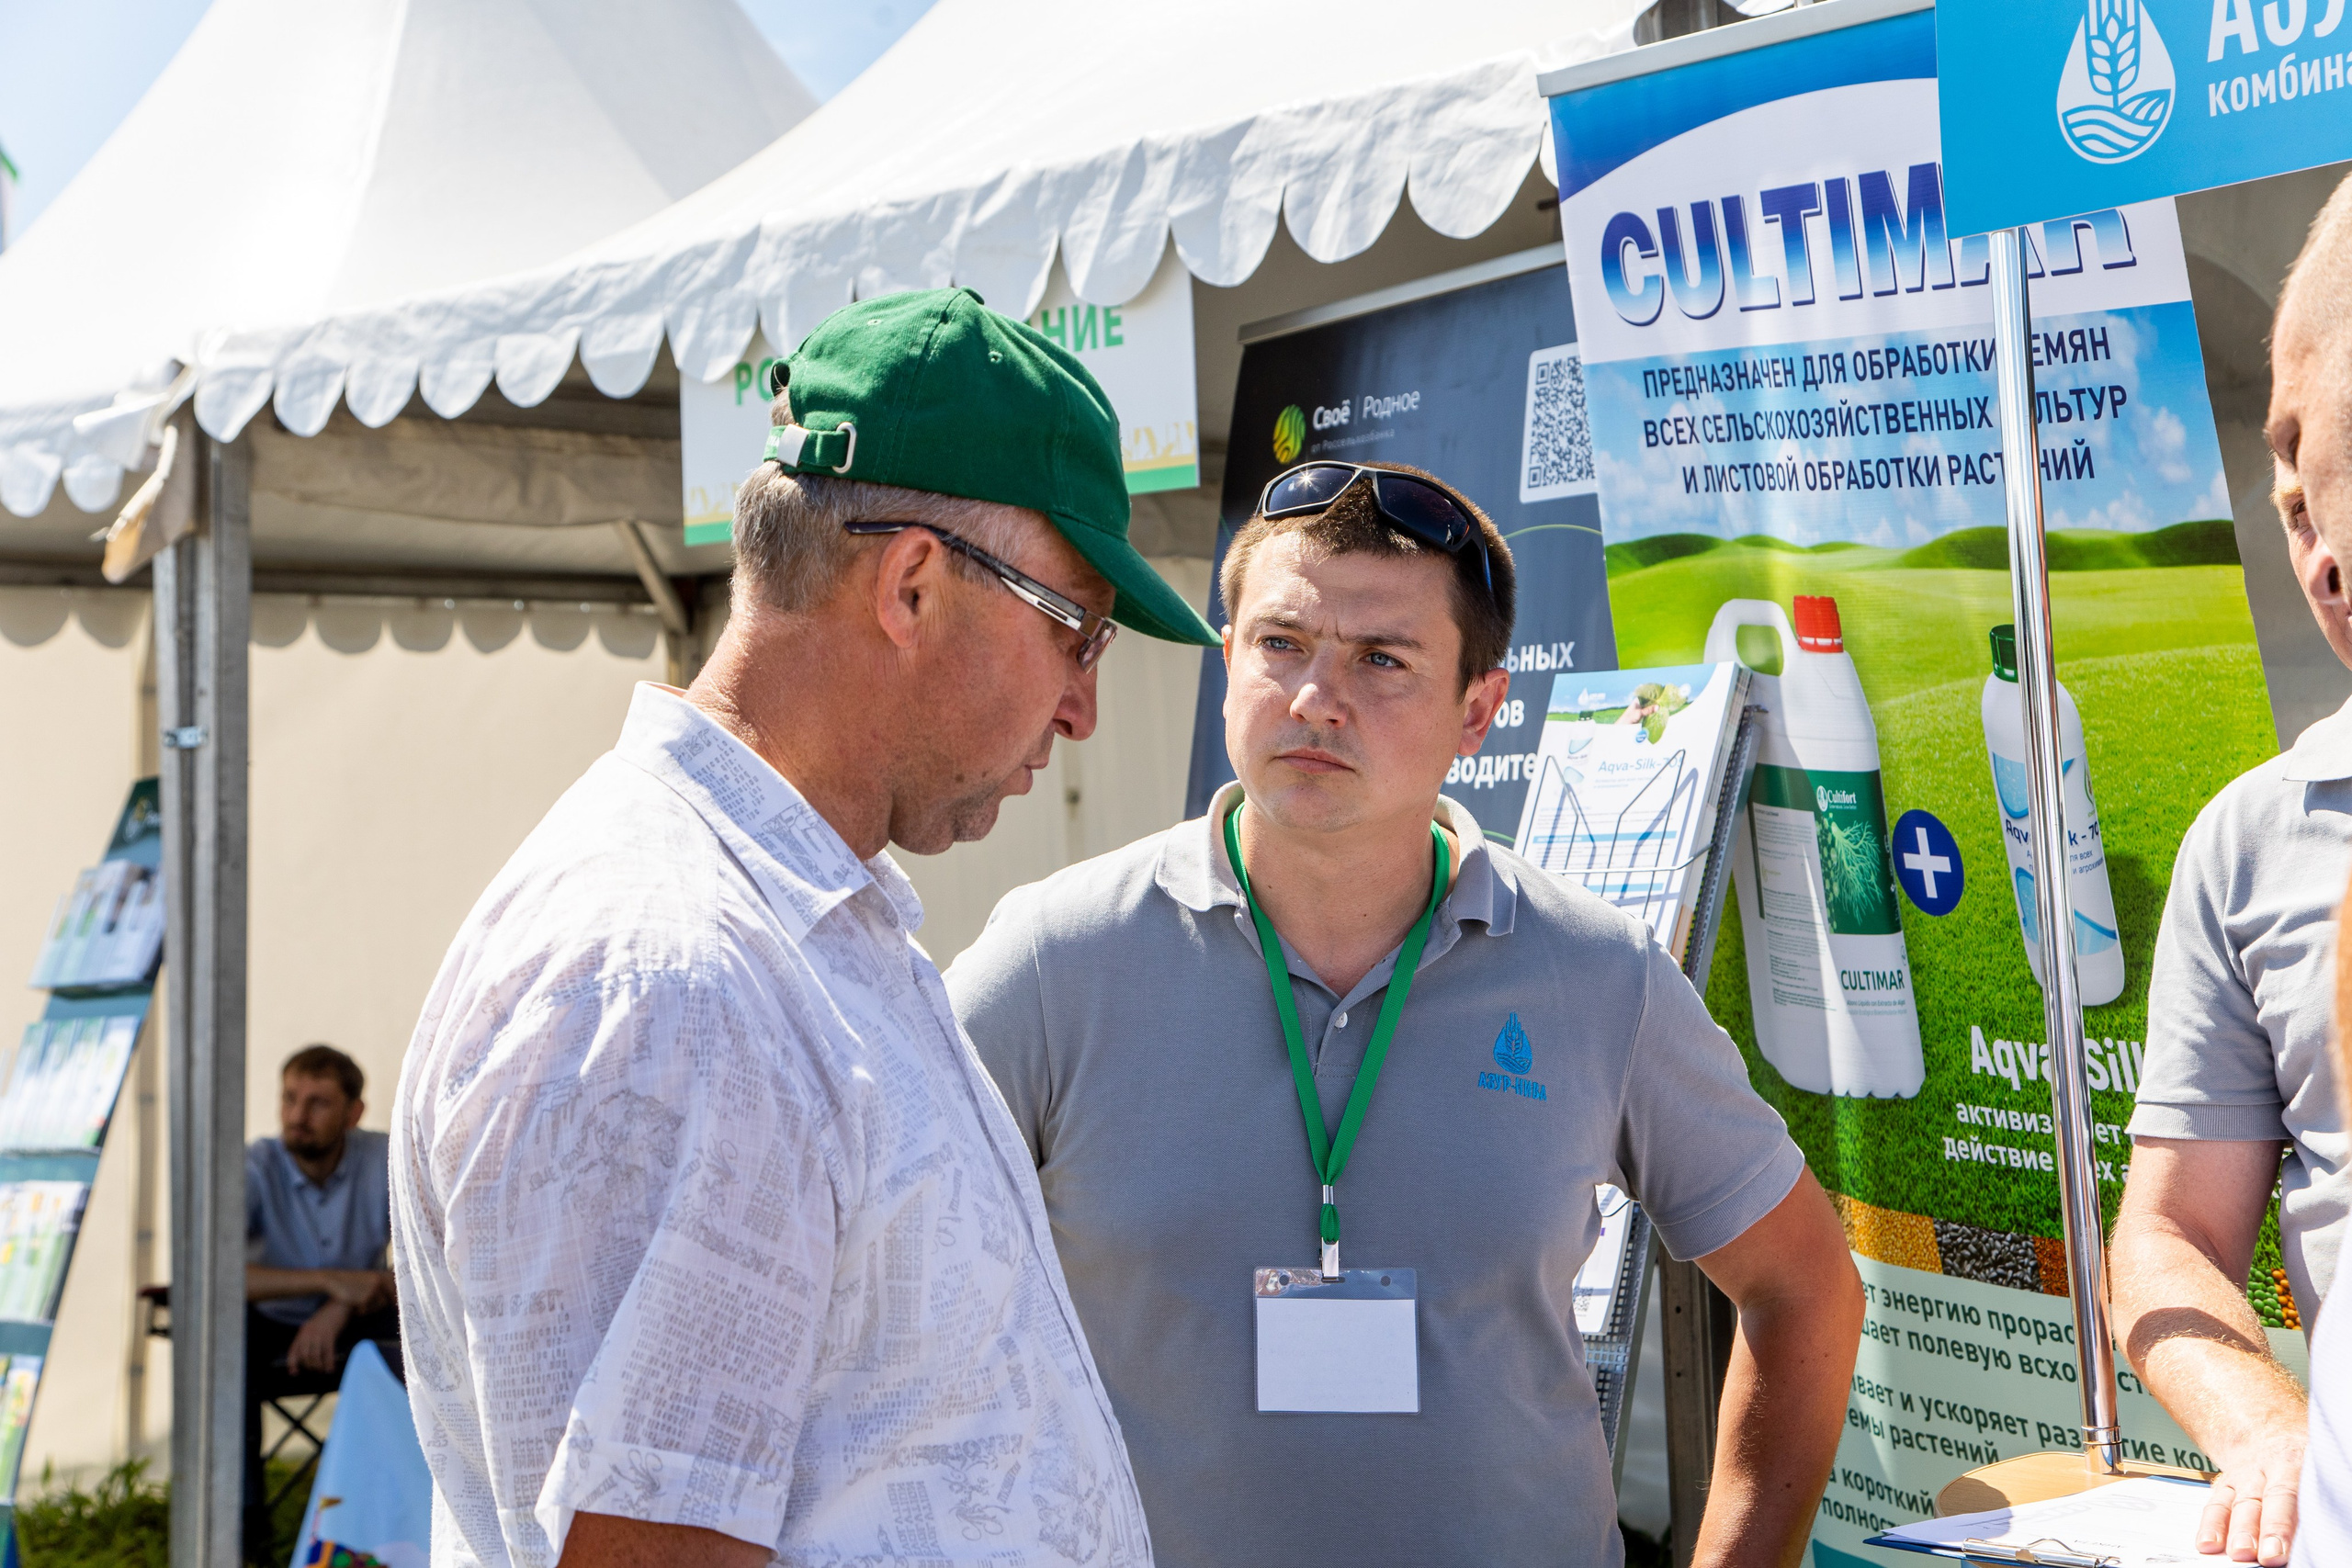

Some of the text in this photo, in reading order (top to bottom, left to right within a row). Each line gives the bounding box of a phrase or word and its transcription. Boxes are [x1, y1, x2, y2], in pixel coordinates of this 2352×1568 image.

[1040, 304, 1125, 353] НИЕ
[1643, 326, 2111, 400] ПРЕДНАЗНАЧЕН ДЛЯ ОБРАБОТКИ ЕМЯН
[1313, 390, 1420, 431] Своё Родное
[1644, 384, 2128, 447] ВСЕХ СЕЛЬСКОХОЗЯЙСТВЕННЫХ ЛЬТУР
[1682, 438, 2095, 493] И ЛИСТОВОЙ ОБРАБОТКИ РАСТНИЙ
[1506, 641, 1576, 673] ьных
[1827, 789, 1857, 805] Cultifort
[2006, 818, 2030, 844] Aqv
[1840, 969, 1905, 991] CULTIMAR
[1478, 1071, 1547, 1101] АЗУР-НИВА
[1943, 1134, 2054, 1172] действие
[1883, 1288, 1981, 1325] энергию
[1987, 1309, 2075, 1346] прорас
[1907, 1330, 2012, 1371] полевую
[1900, 1392, 1915, 1412] и
[1919, 1396, 2029, 1438] ускоряет
[1889, 1425, 1999, 1465] растений
[1842, 1468, 1935, 1516] короткий
